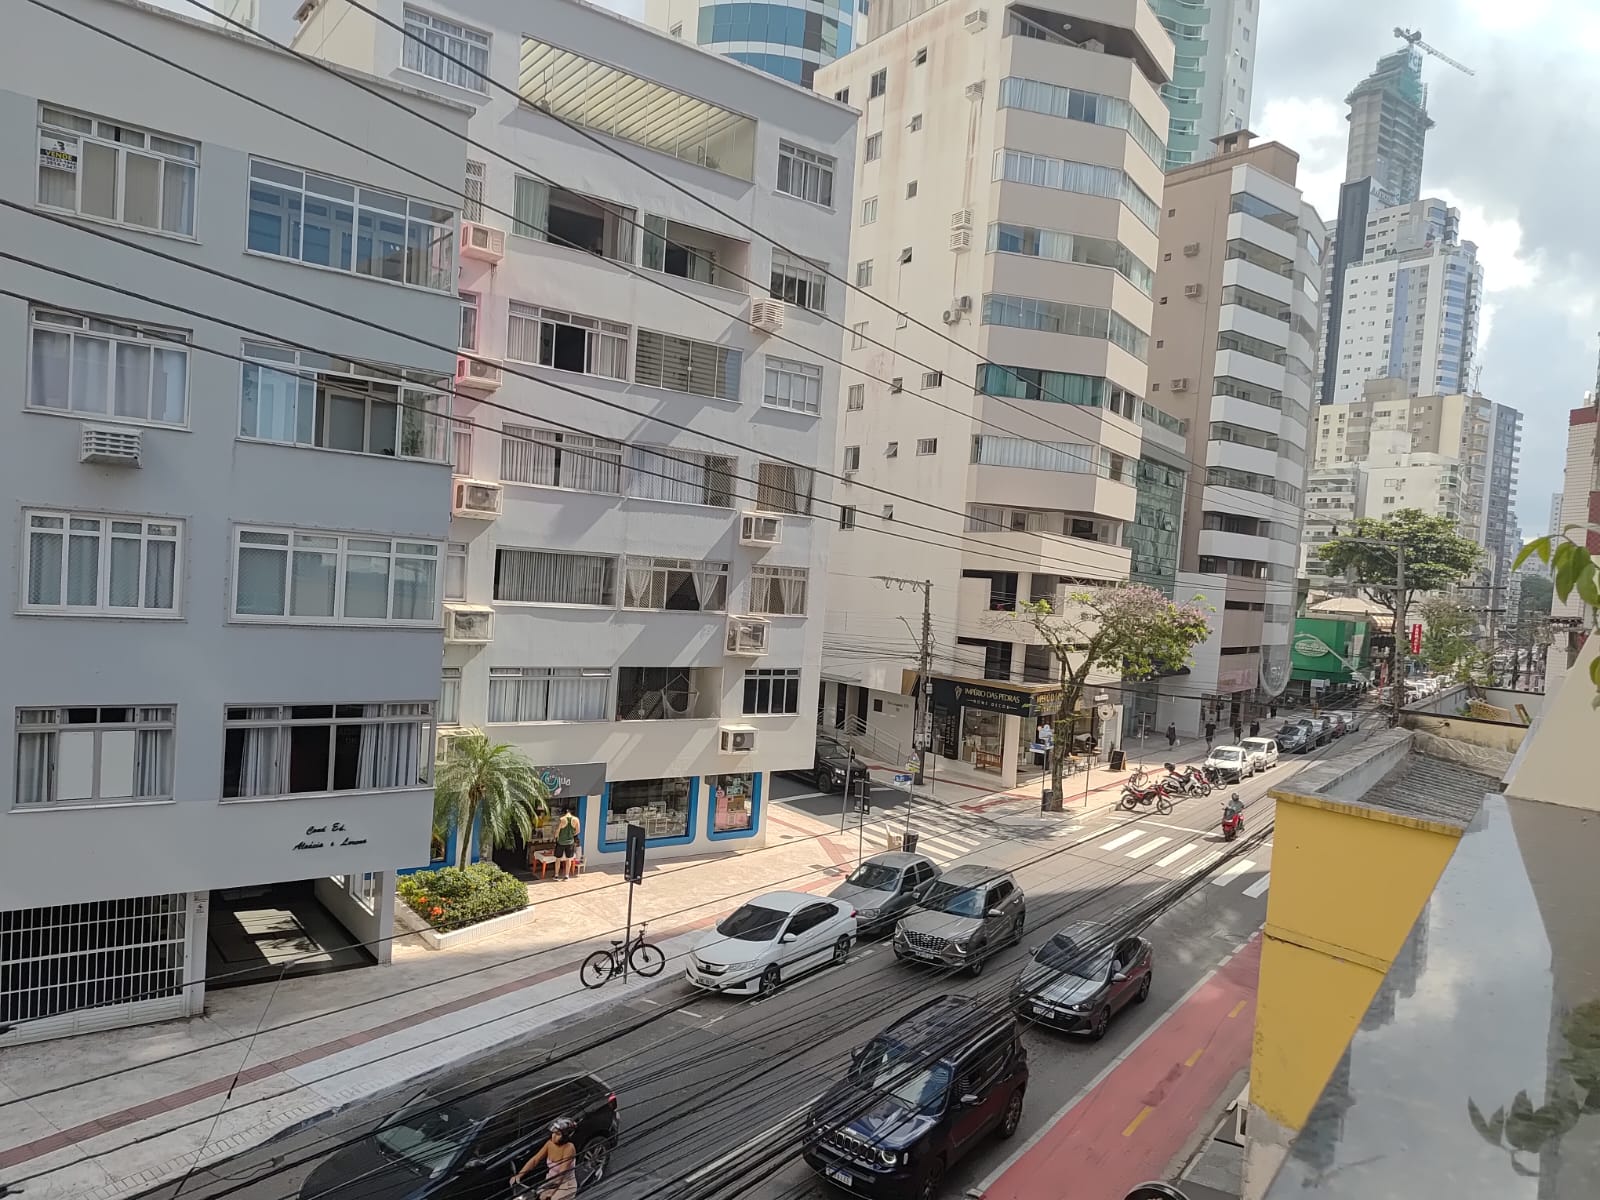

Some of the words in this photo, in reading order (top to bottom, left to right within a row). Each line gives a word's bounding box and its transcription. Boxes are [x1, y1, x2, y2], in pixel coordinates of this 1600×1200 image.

[46, 150, 73, 160] VENDE
[986, 691, 999, 700] DAS
[998, 693, 1020, 704] PEDRAS
